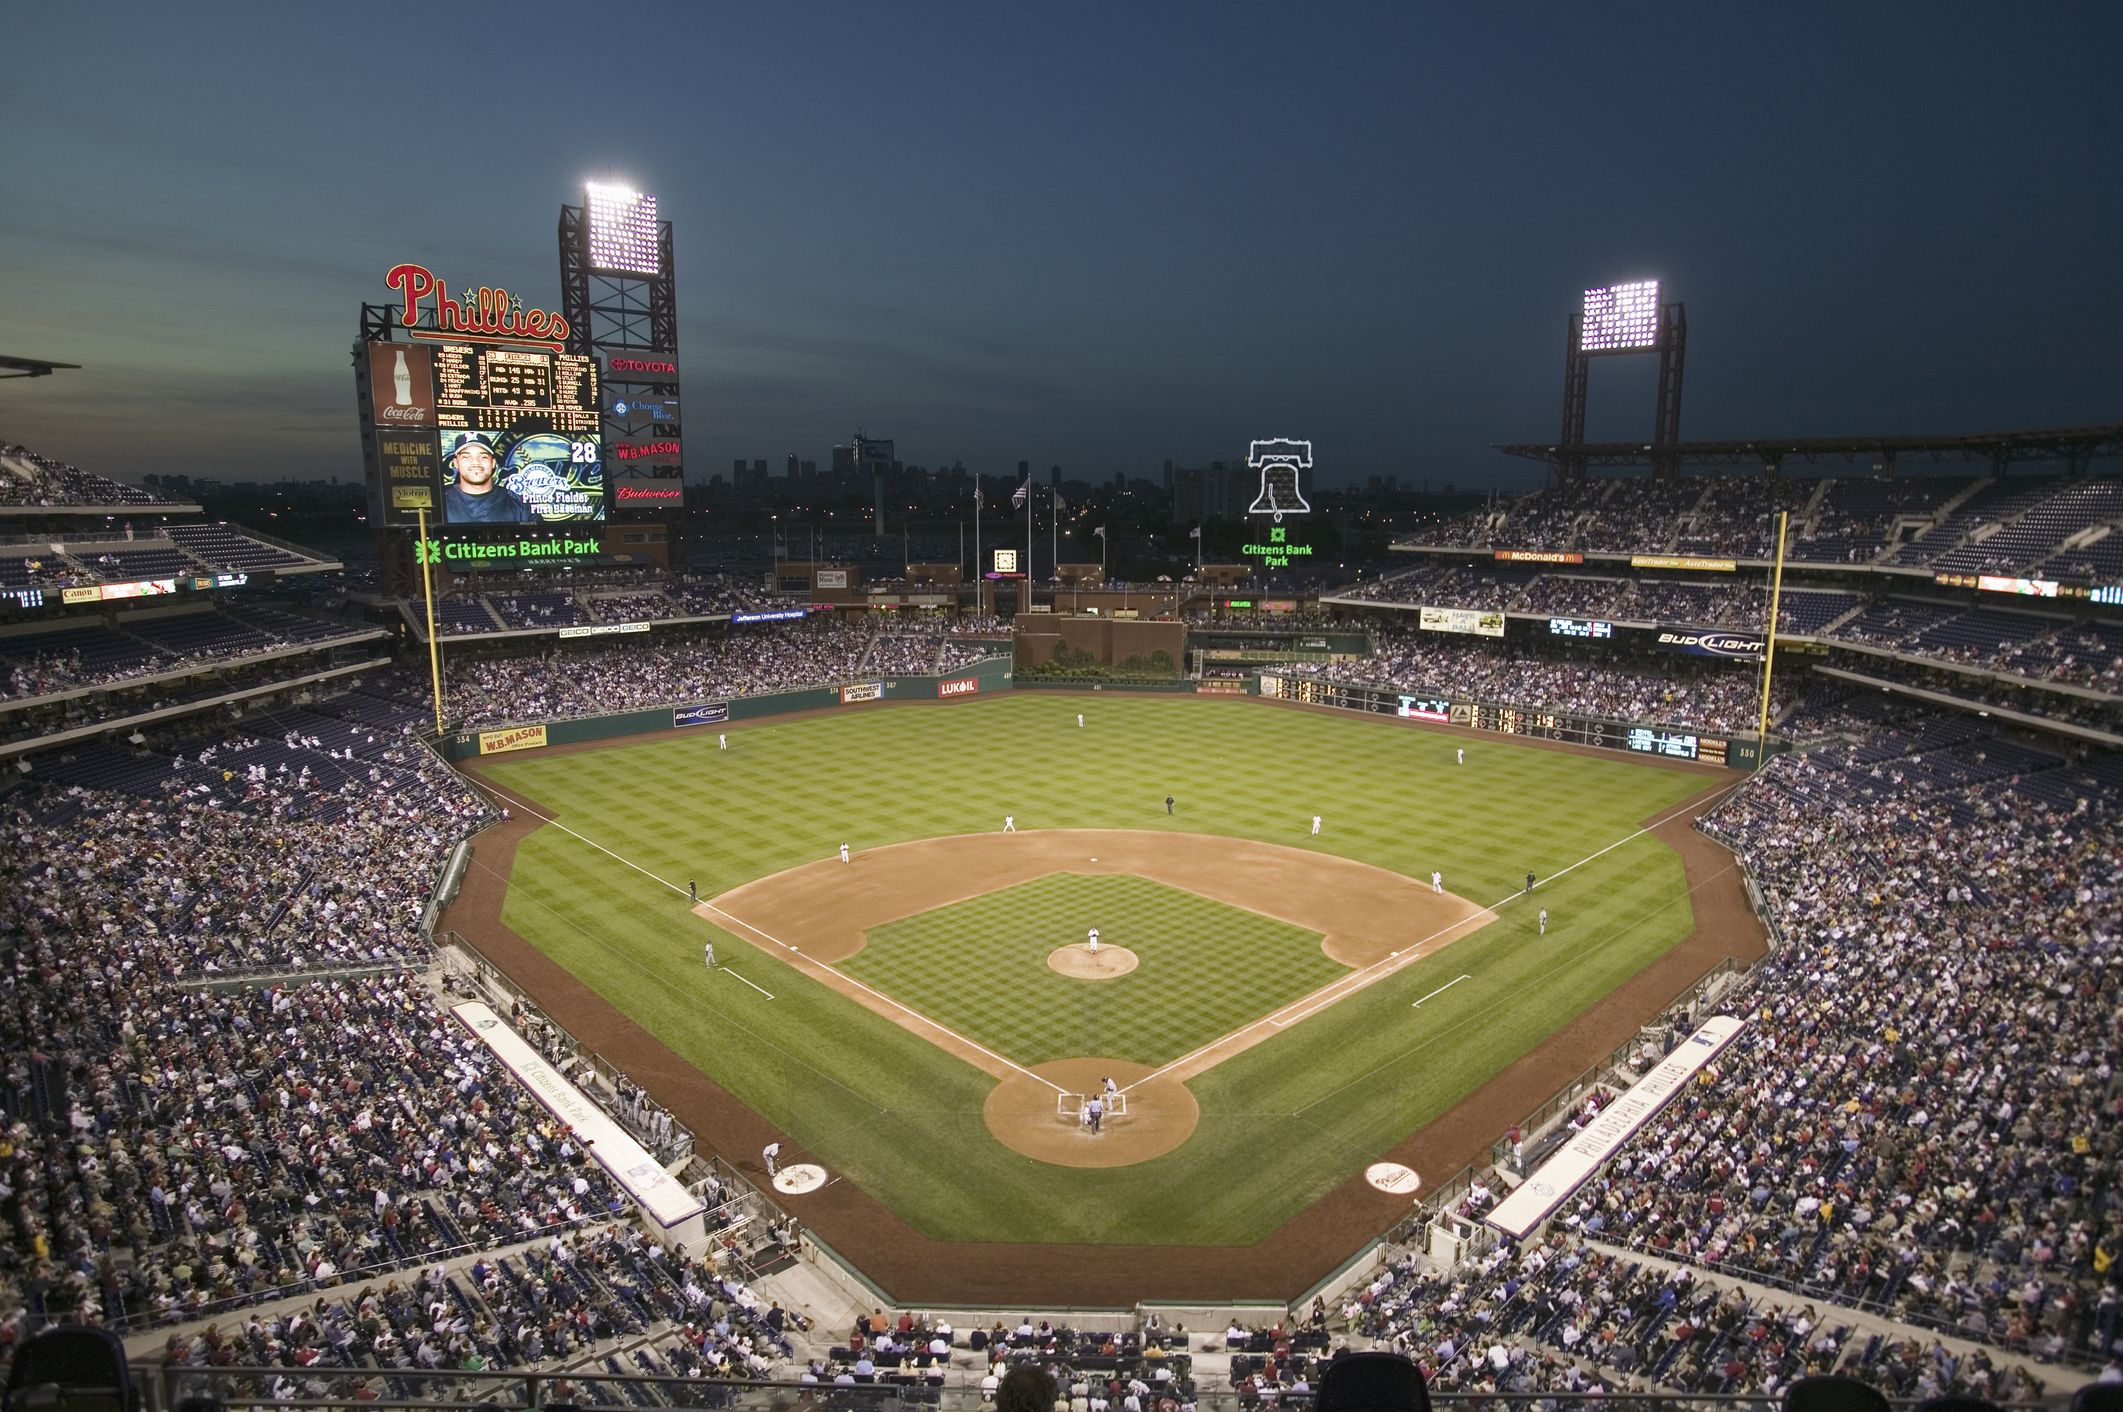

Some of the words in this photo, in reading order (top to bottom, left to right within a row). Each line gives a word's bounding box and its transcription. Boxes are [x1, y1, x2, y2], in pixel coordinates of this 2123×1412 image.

[386, 263, 570, 340] Phillies
[443, 345, 474, 354] BREWERS
[559, 354, 589, 363] PHILLIES
[508, 366, 521, 374] 146
[628, 360, 675, 373] TOYOTA
[510, 376, 520, 384] 25
[537, 378, 545, 386] 31
[632, 400, 664, 411] Choose
[383, 405, 427, 421] Coca-Cola
[652, 410, 674, 420] Blue.
[572, 442, 597, 463] 28
[390, 465, 430, 478] MUSCLE
[506, 473, 571, 495] Brewers
[522, 492, 553, 504] Prince
[555, 492, 589, 503] Fielder
[616, 487, 681, 499] Budweiser
[530, 503, 552, 514] First
[554, 503, 593, 514] Baseman
[445, 542, 516, 560] Citizens
[520, 539, 563, 556] Bank
[564, 538, 600, 555] Park
[1242, 544, 1284, 555] Citizens
[1286, 544, 1312, 555] Bank
[1265, 556, 1289, 567] Park
[1511, 551, 1565, 562] McDonald's
[63, 589, 93, 598] Canon
[784, 610, 804, 618] Hospital
[1452, 611, 1475, 619] HAVE
[561, 628, 589, 637] GEICO
[592, 626, 619, 634] GEICO
[621, 623, 649, 632] GEICO
[1658, 634, 1699, 646] BUD
[1707, 638, 1765, 652] LIGHT
[845, 685, 880, 695] SOUTHWEST
[850, 692, 876, 700] AIRLINES
[675, 711, 697, 720] BUD
[698, 707, 727, 718] LIGHT
[485, 727, 543, 751] W.B.MASON
[1700, 738, 1727, 747] MODELL'S
[1699, 753, 1726, 763] MODELL'S
[1739, 748, 1755, 758] 330
[531, 1070, 559, 1093] Citizens
[554, 1092, 576, 1108] Bank
[570, 1107, 591, 1123] Park
[1572, 1098, 1650, 1158] PHILADELPHIA
[1641, 1063, 1688, 1096] PHILLIES
